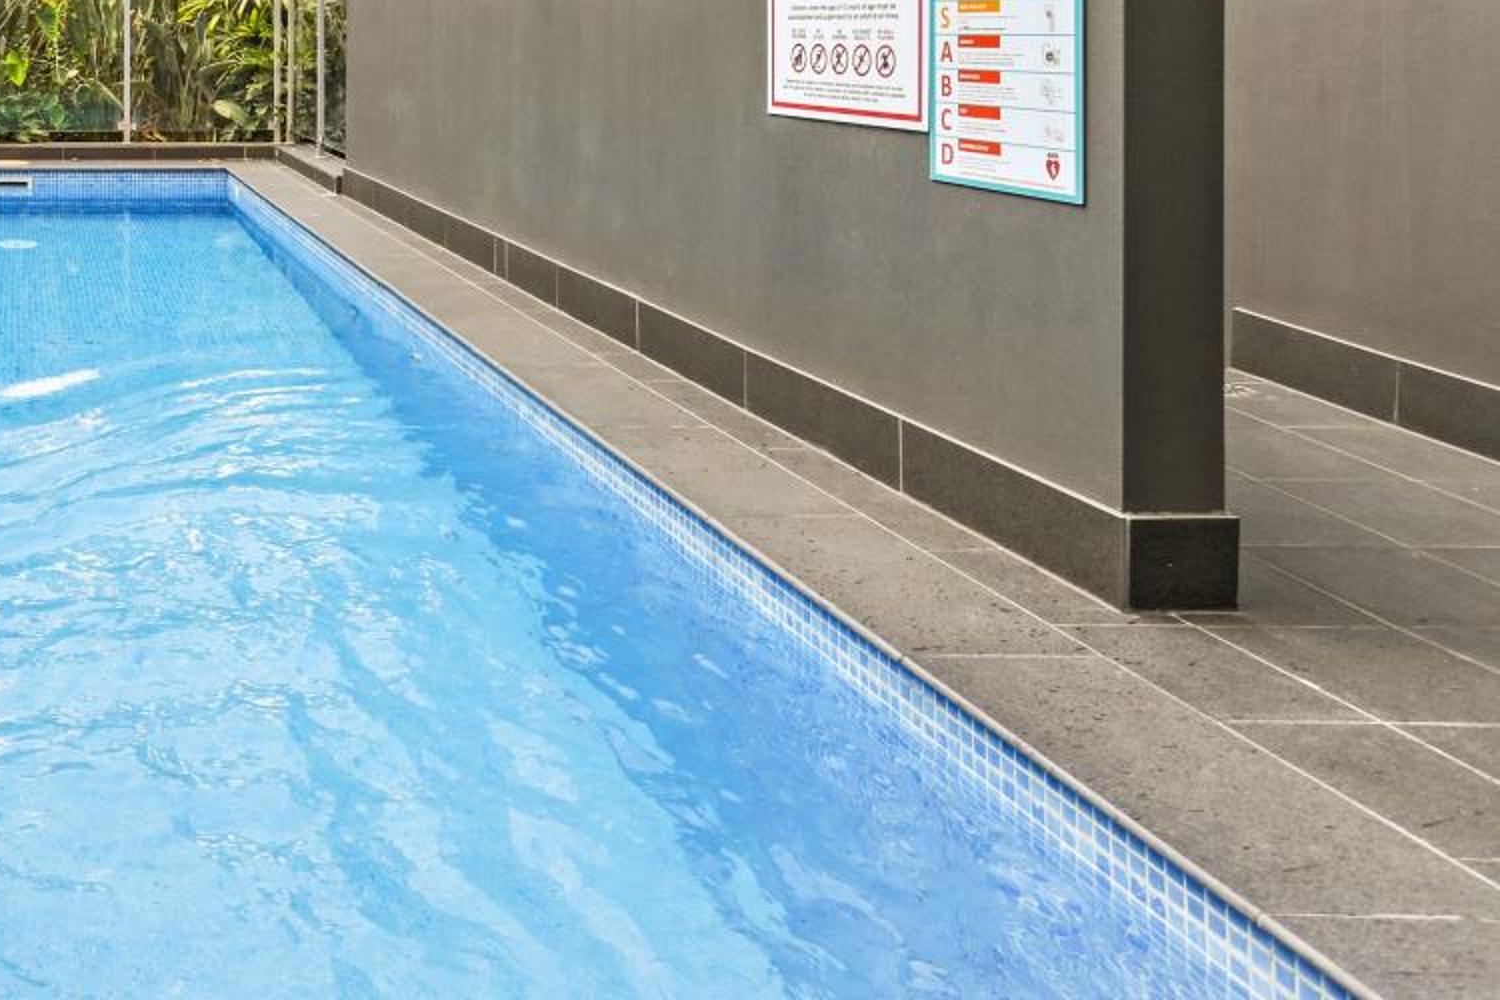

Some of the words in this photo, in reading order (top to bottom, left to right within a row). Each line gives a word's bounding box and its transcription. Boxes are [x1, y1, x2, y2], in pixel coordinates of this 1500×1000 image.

[940, 7, 950, 28] S
[940, 41, 953, 62] A
[941, 75, 952, 96] B
[941, 109, 952, 130] C
[941, 143, 954, 164] D
